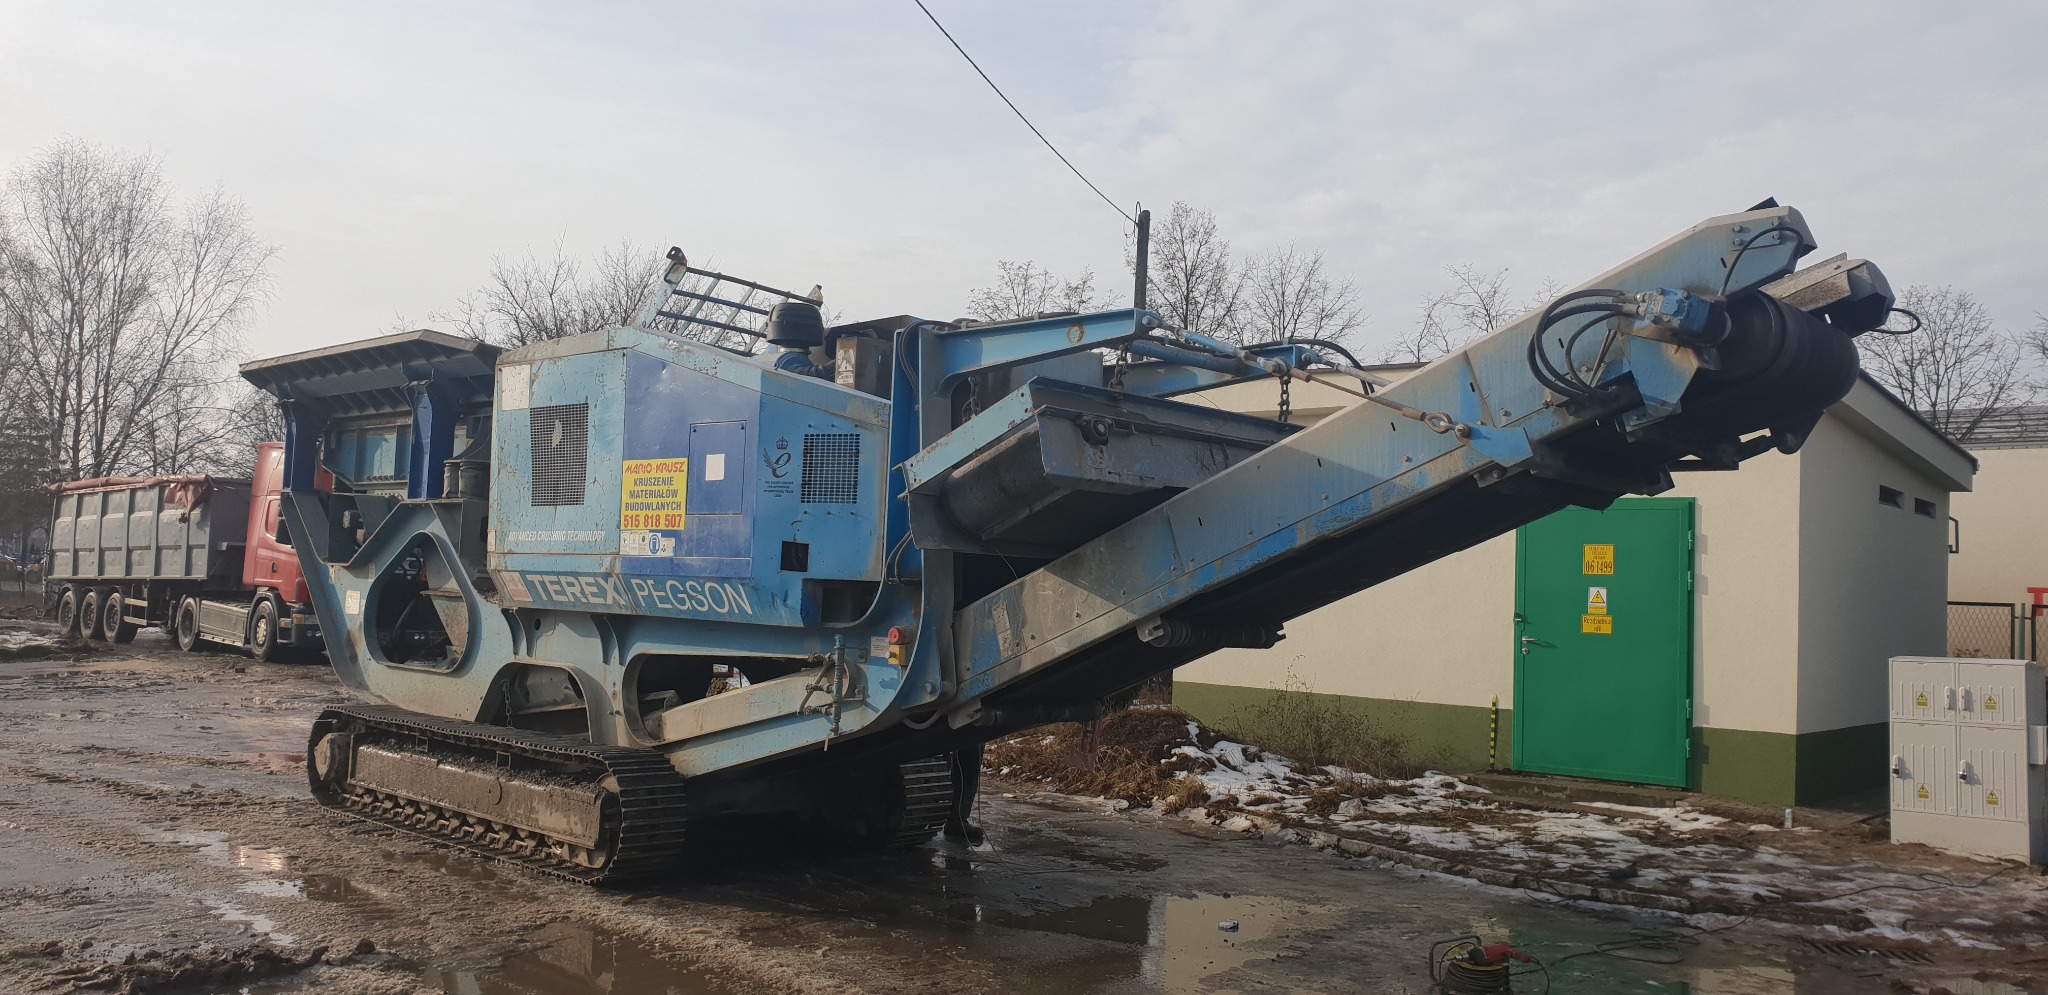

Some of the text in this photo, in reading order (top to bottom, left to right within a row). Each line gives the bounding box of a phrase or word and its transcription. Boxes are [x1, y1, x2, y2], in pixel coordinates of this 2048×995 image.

[624, 461, 686, 475] MARIO-KRUSZ
[633, 476, 675, 487] KRUSZENIE
[629, 486, 679, 499] MATERIAŁÓW
[625, 501, 682, 512] BUDOWLANYCH
[623, 513, 683, 528] 515 818 507
[507, 531, 537, 541] ADVANCED
[567, 530, 606, 541] TECHNOLOGY
[525, 574, 753, 616] TEREX PEGSON
